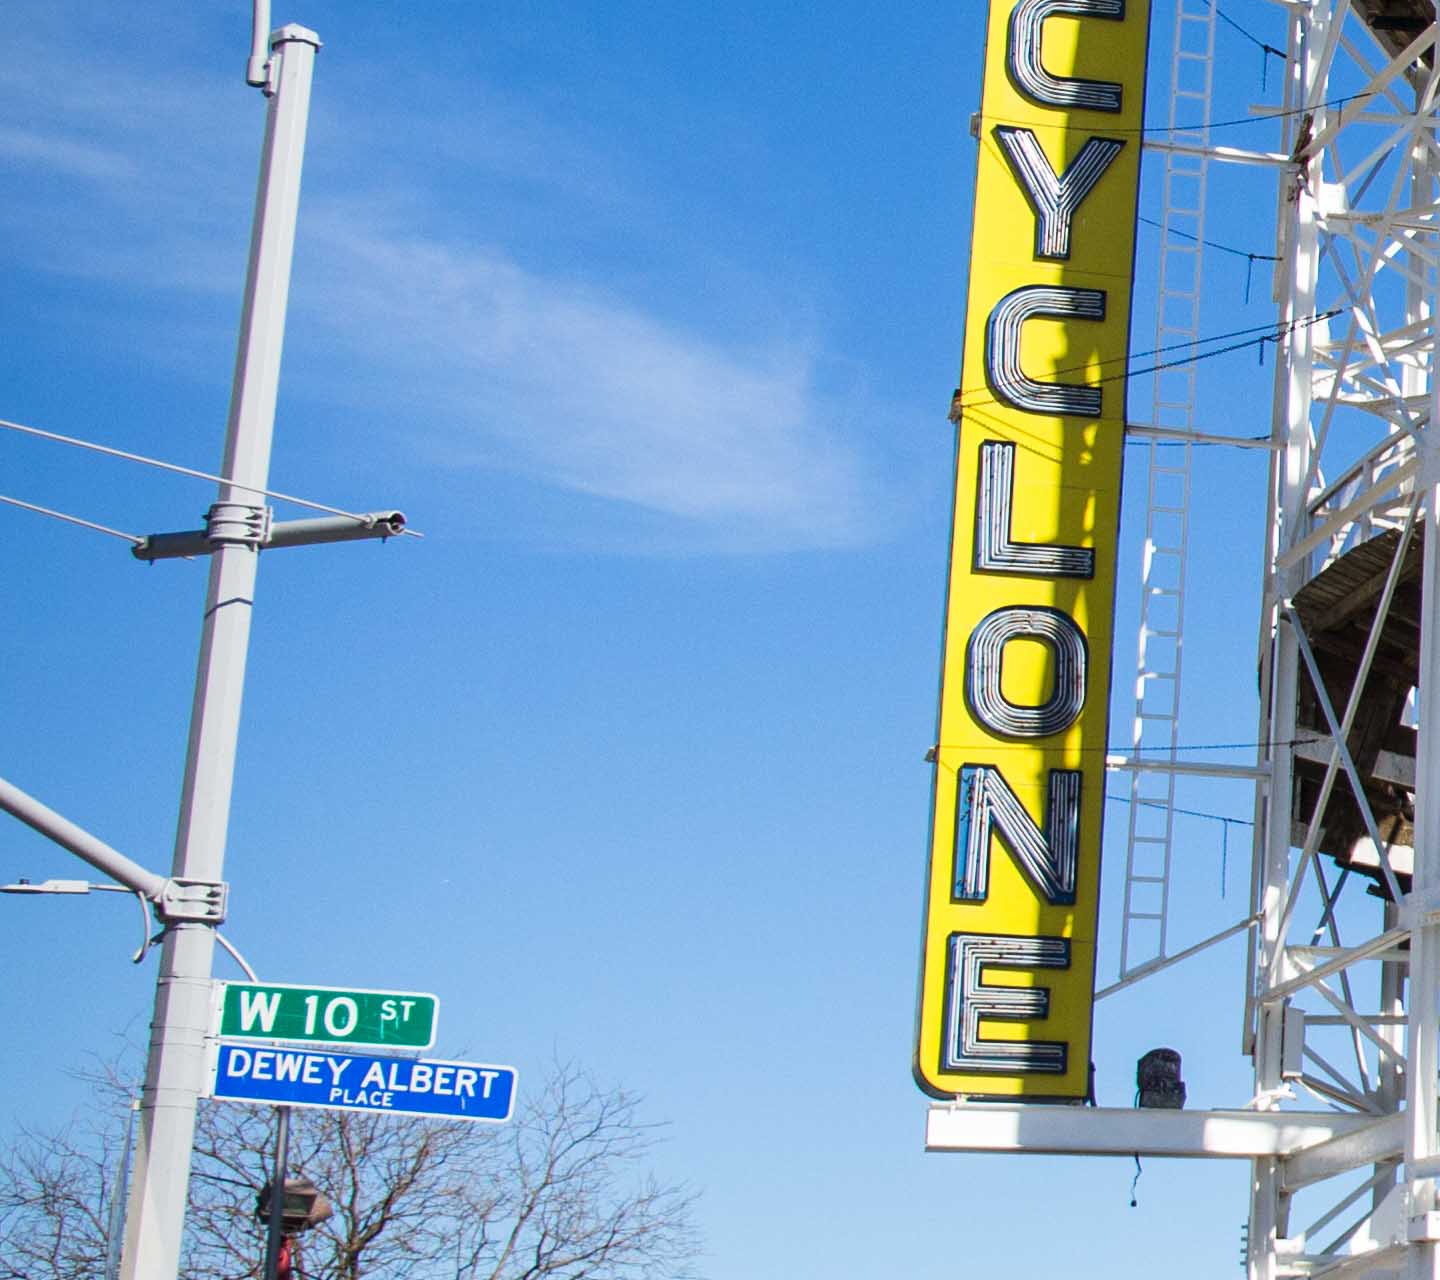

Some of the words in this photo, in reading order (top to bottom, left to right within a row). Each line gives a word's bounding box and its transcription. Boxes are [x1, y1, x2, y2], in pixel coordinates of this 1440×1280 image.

[239, 991, 282, 1033] W
[303, 995, 359, 1037] 10
[380, 999, 416, 1022] ST
[226, 1049, 352, 1087] DEWEY
[360, 1061, 500, 1099] ALBERT
[328, 1088, 394, 1107] PLACE
